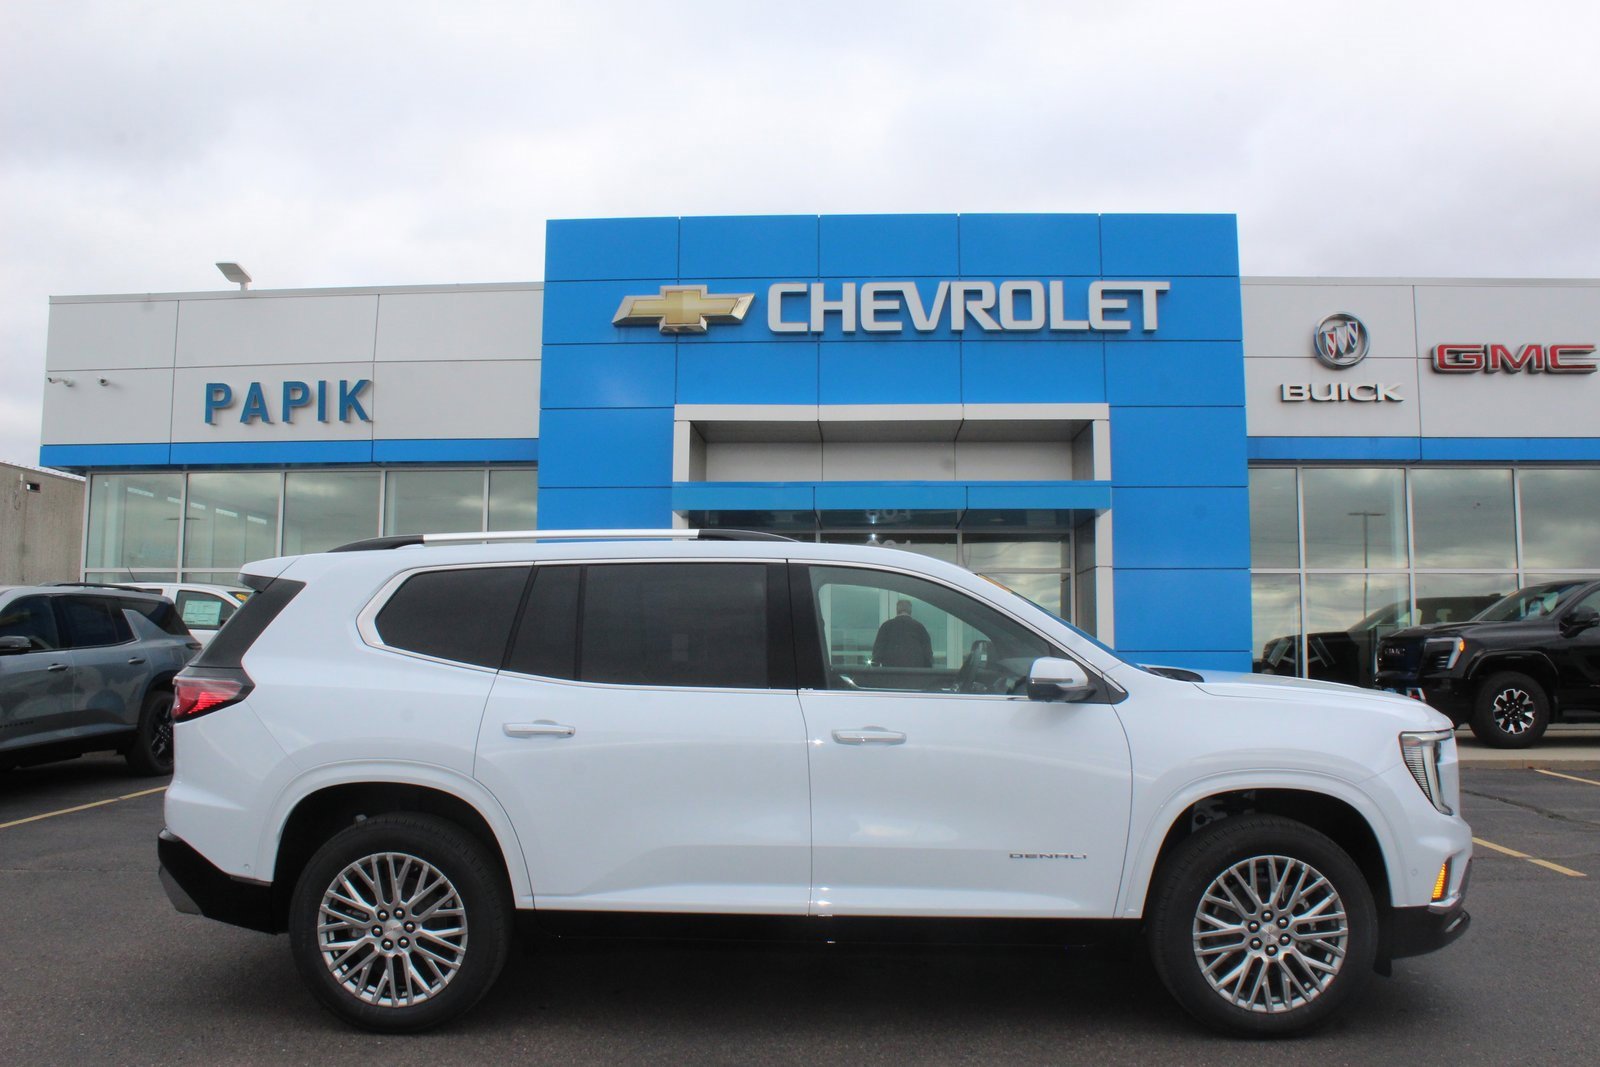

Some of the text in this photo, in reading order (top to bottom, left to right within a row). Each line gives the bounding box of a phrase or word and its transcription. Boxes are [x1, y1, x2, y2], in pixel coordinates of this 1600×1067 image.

[766, 281, 1171, 334] CHEVROLET
[1431, 343, 1598, 375] GMC
[204, 379, 374, 426] PAPIK
[1280, 382, 1405, 403] BUICK
